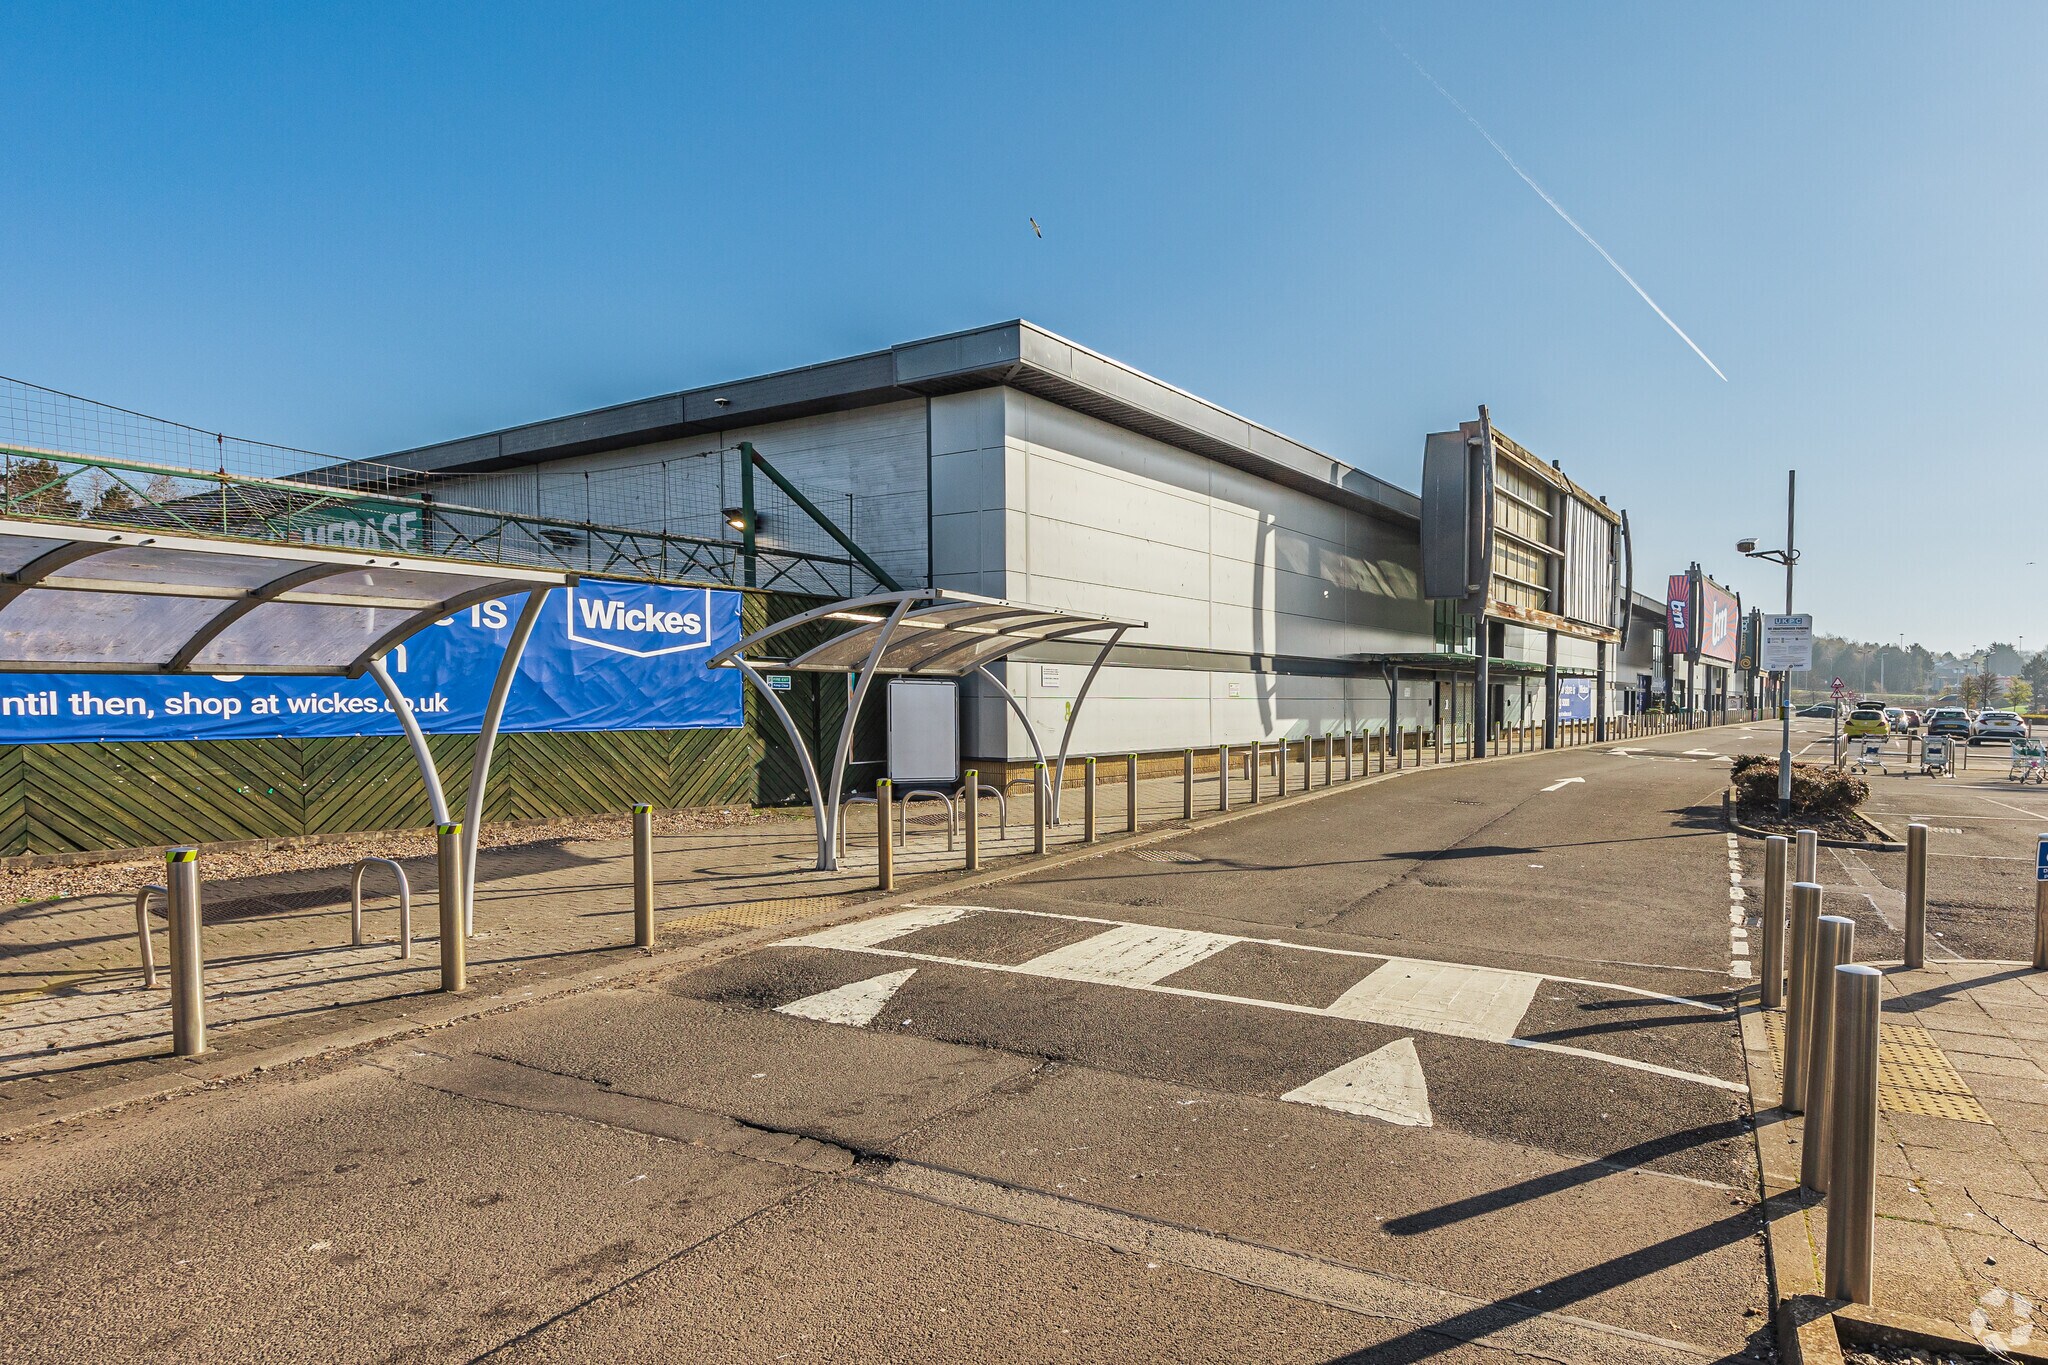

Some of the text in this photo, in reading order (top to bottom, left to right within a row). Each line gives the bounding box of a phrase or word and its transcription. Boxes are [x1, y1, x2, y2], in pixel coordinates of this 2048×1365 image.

[471, 600, 508, 629] is
[579, 598, 702, 635] Wickes
[2, 691, 57, 715] ntil
[68, 691, 154, 719] then,
[165, 692, 242, 719] shop
[251, 694, 280, 714] at
